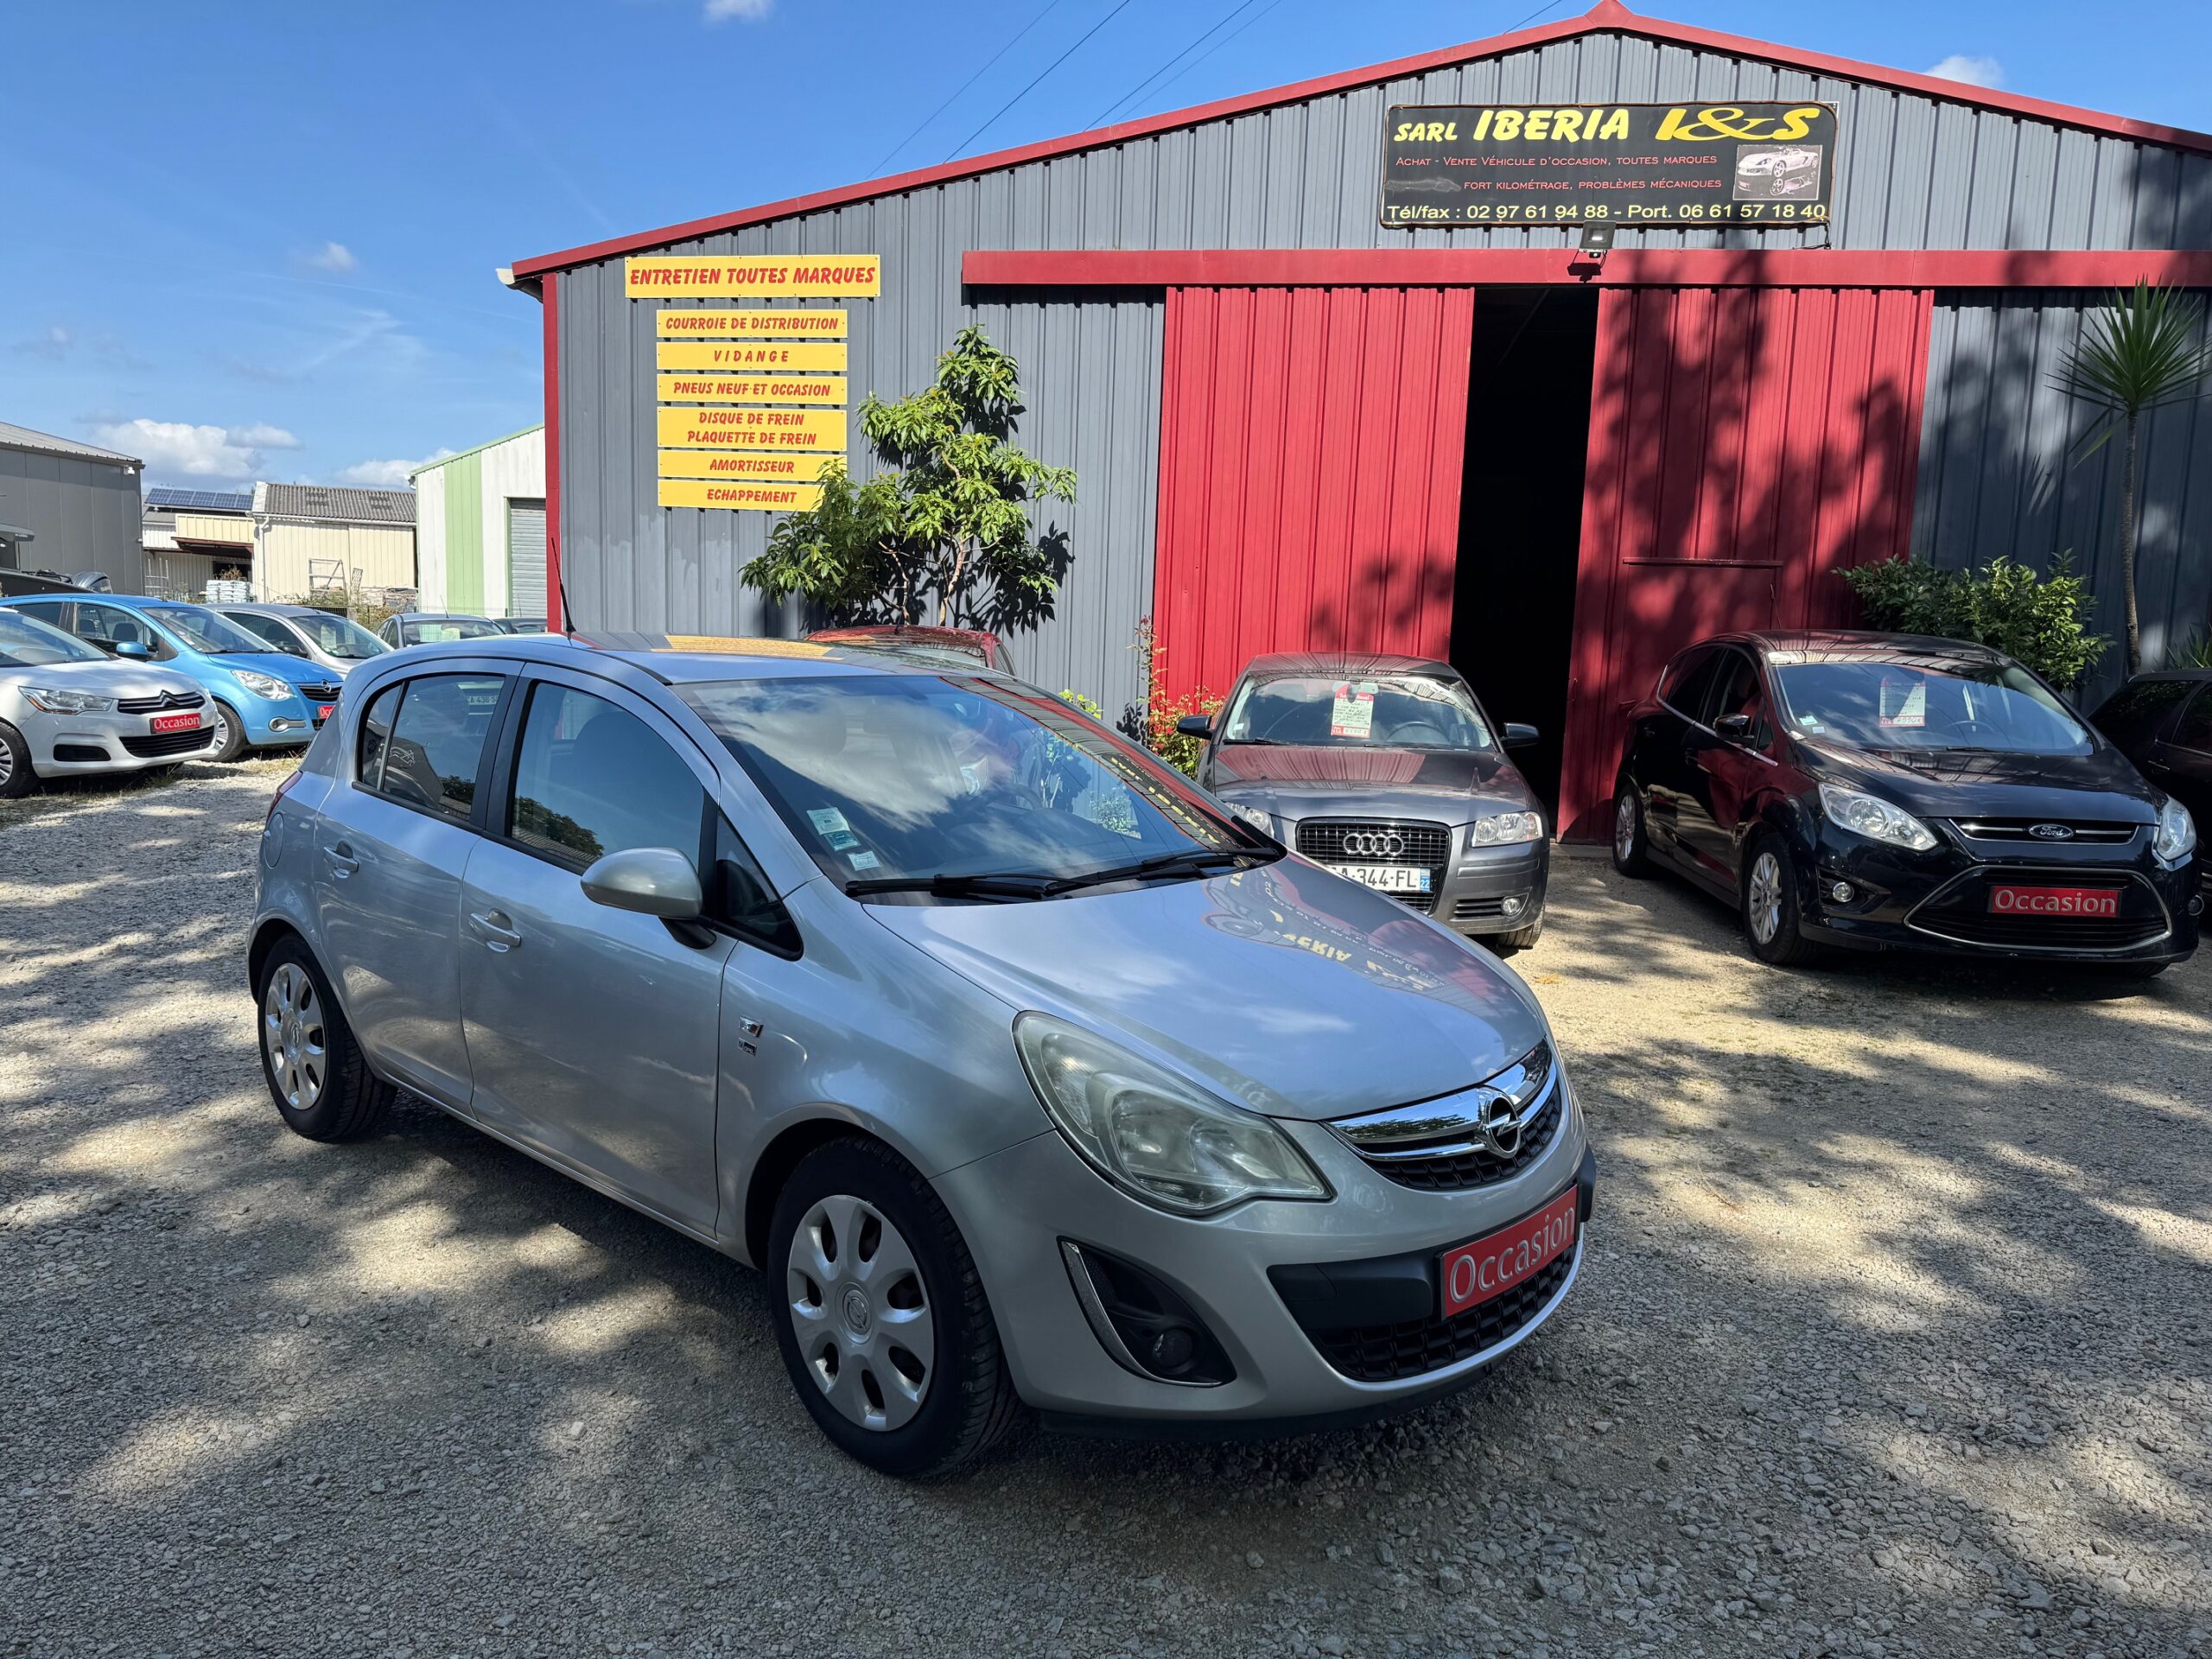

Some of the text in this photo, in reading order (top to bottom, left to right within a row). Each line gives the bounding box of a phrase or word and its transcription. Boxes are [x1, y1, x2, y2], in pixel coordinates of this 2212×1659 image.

[1394, 107, 1821, 143] SARL IBERIA I&S
[1616, 156, 1659, 165] TOUTES
[1663, 156, 1718, 165] MARQUES
[1464, 178, 1722, 191] FORT KILOMÉTRAGE, PROBLÈMES MÉCANIQUES
[1387, 205, 1450, 219] Tél/fax
[1466, 205, 1490, 219] 02
[1496, 205, 1520, 219] 97
[1525, 205, 1547, 219] 61
[1554, 205, 1579, 219] 94
[1584, 205, 1608, 219] 88
[1627, 204, 1672, 219] Port.
[1679, 204, 1704, 219] 06
[1709, 204, 1732, 218] 61
[1739, 204, 1764, 218] 57
[1772, 204, 1795, 218] 18
[1800, 204, 1826, 218] 40
[630, 267, 875, 285] ENTRETIEN TOUTES MARQUES
[666, 317, 838, 330] COURROIE DE DISTRIBUTION
[714, 350, 789, 362] VIDANGE
[673, 382, 830, 397] PNEUS NEUF ET OCCASION
[699, 412, 804, 427] DISQUE DE FREIN
[688, 430, 817, 445] PLAQUETTE DE FREIN
[709, 459, 795, 474] AMORTISSEUR
[707, 488, 797, 503] ECHAPPEMENT
[154, 715, 200, 730] Occasion
[2039, 824, 2064, 836] Ford
[1420, 879, 1430, 889] 22
[1995, 889, 2115, 913] Occasion
[1449, 1206, 1576, 1304] Occasion
